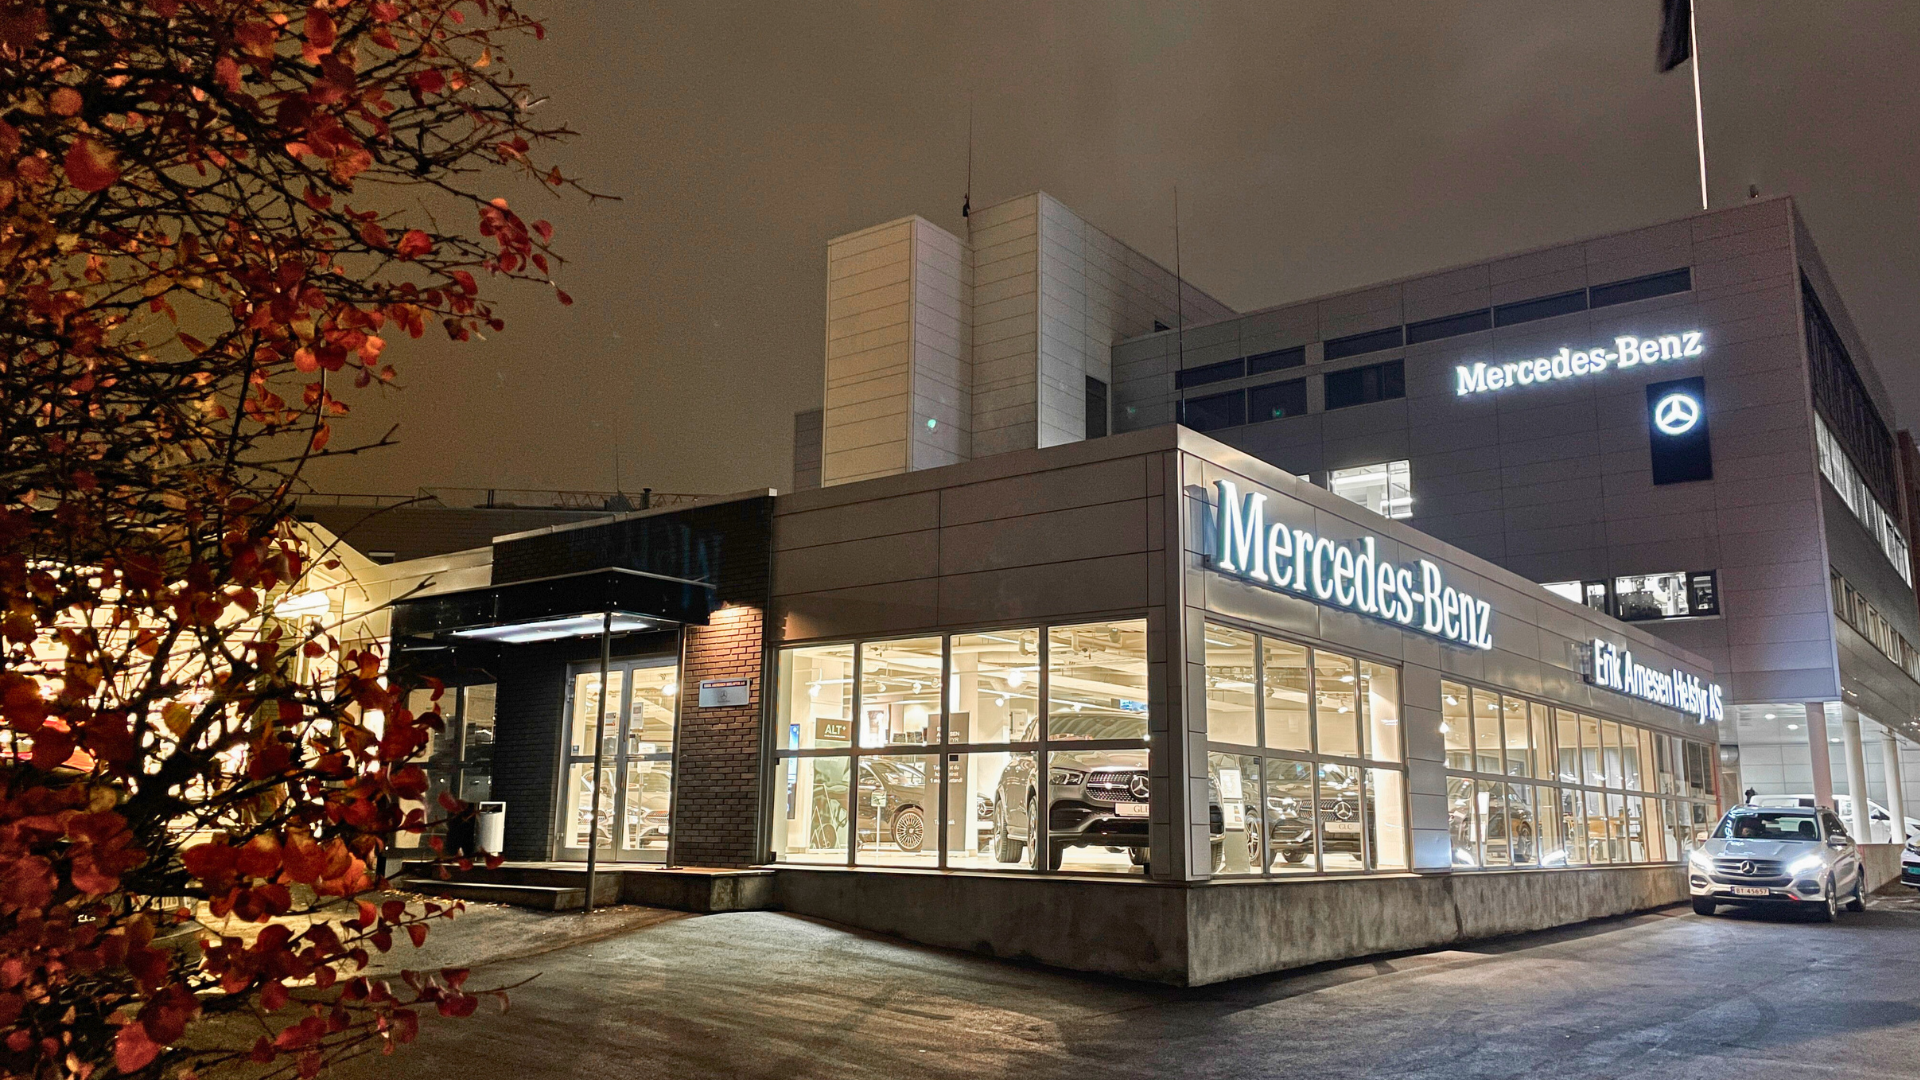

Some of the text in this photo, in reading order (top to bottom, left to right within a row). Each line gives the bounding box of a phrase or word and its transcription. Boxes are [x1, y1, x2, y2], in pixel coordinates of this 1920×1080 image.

[1455, 331, 1703, 396] Mercedes-Benz
[1212, 479, 1493, 650] Mercedes-Benz
[1594, 637, 1623, 690] Erik
[1709, 683, 1724, 722] AS
